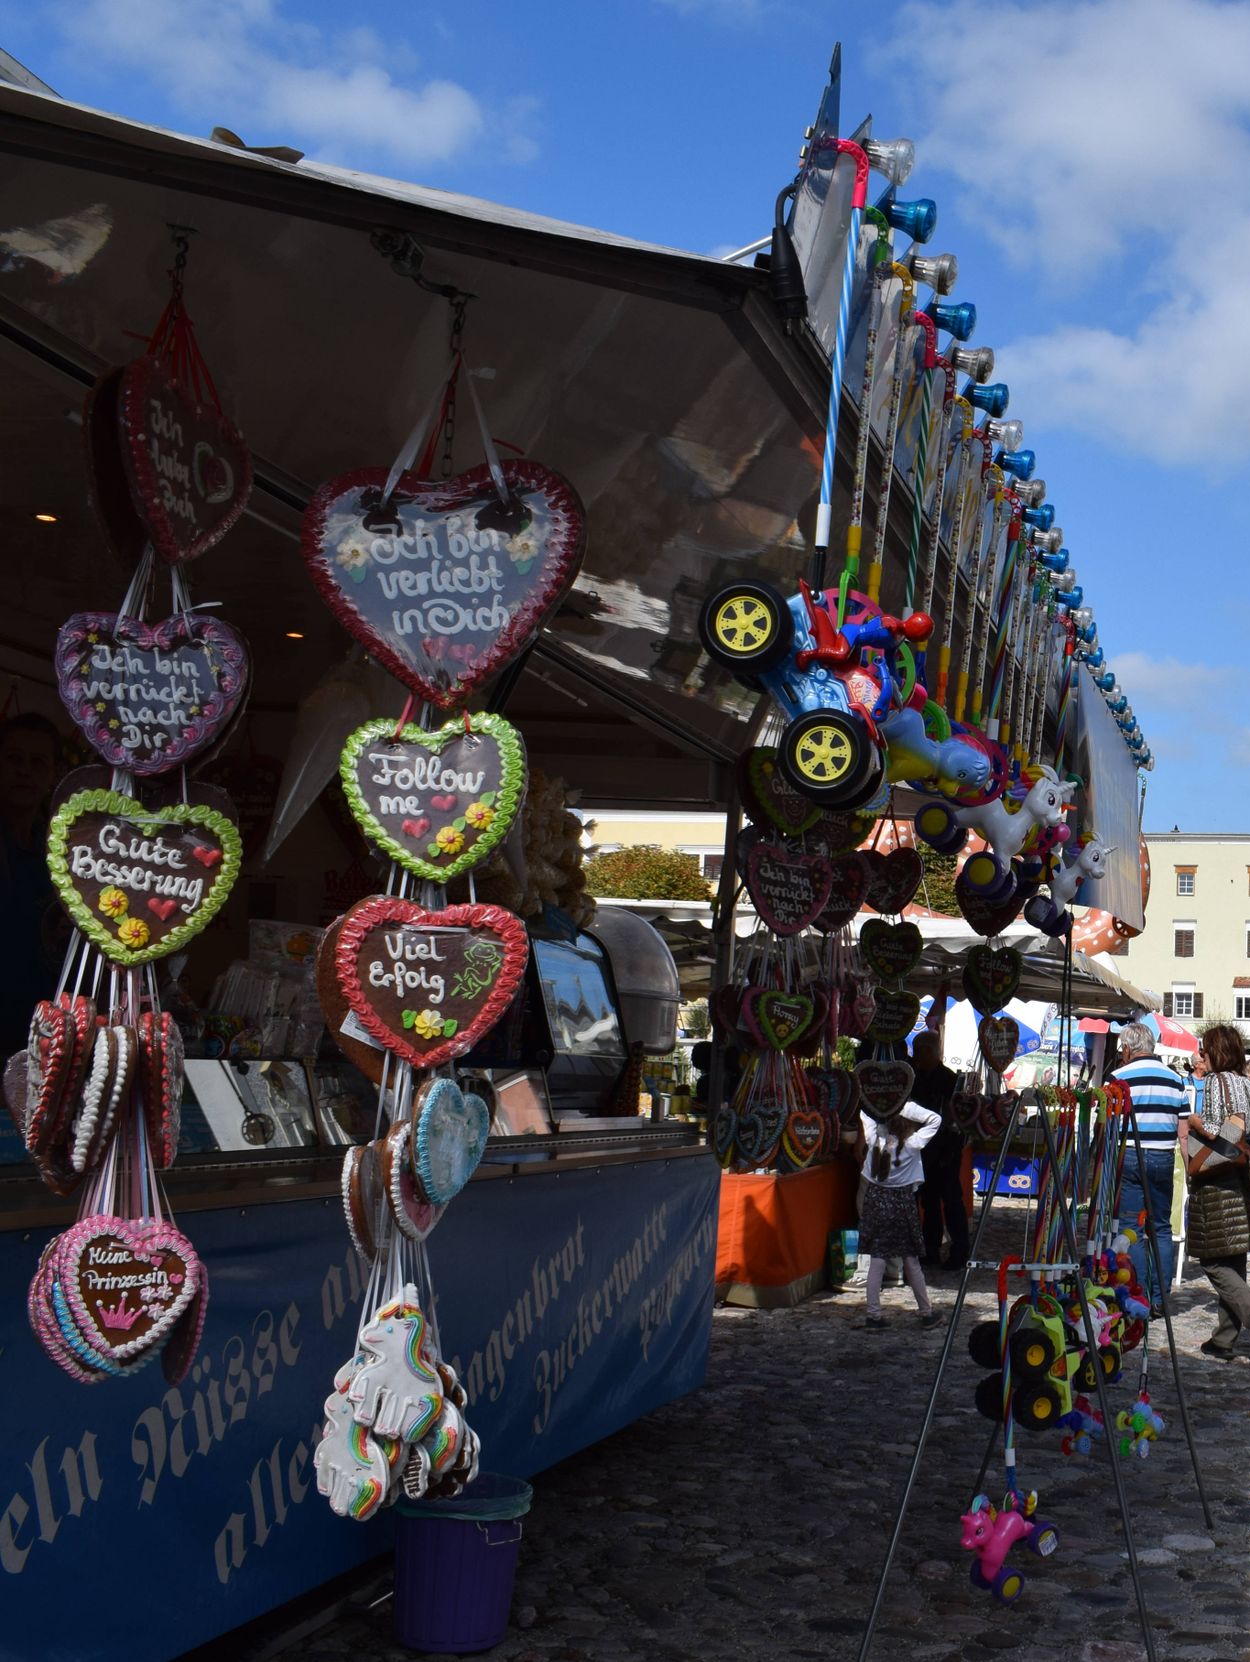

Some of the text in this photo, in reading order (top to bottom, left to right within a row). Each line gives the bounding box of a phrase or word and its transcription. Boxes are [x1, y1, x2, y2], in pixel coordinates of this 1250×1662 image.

[370, 514, 501, 565] Ich bin
[376, 554, 505, 600] verliebt
[422, 594, 510, 635] Dich
[91, 644, 200, 677] Ich bin
[81, 675, 204, 704] verrückt
[118, 703, 191, 725] nach
[121, 725, 168, 749] Dir
[368, 753, 486, 794] Follow
[379, 795, 425, 816] me
[98, 824, 188, 869] Gute
[71, 845, 204, 914] Besserung
[760, 863, 811, 887] Ich bin
[761, 882, 815, 903] verrückt
[772, 896, 804, 914] nach
[774, 909, 797, 925] Dir
[384, 933, 447, 961] Viel
[368, 960, 446, 1004] Erfolg
[772, 1005, 800, 1030] Honey
[88, 1247, 133, 1265] Meine
[82, 1266, 169, 1290] Prinzessin
[533, 1202, 667, 1435] Zuckerwatte
[131, 1302, 303, 1510] Nüsse
[214, 1423, 326, 1584] alle
